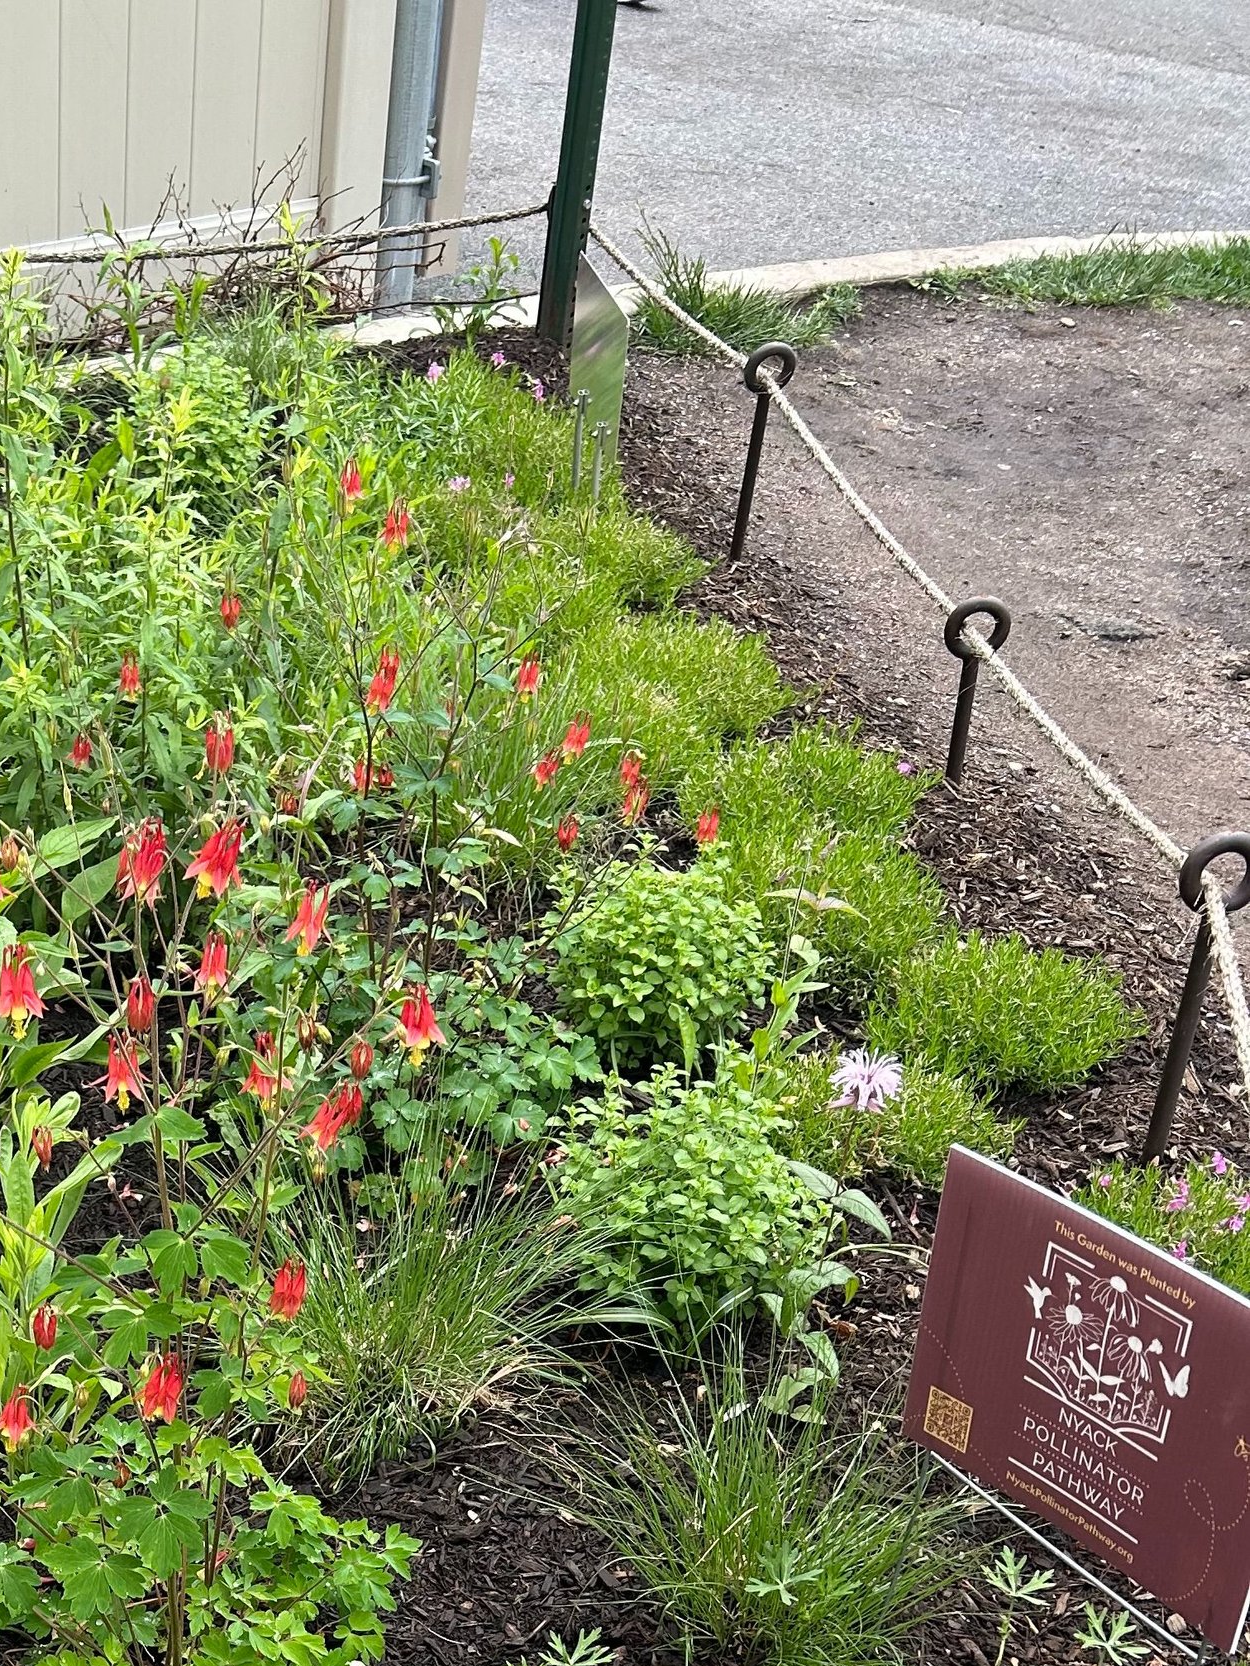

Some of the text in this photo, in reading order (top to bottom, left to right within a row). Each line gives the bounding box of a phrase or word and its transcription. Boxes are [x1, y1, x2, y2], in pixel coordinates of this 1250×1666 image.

[1054, 1220, 1196, 1310] This Garden was Planted by
[1023, 1416, 1144, 1505] POLLINATOR
[1058, 1407, 1118, 1457] NYACK
[1006, 1470, 1134, 1564] NyackPollinatorPathway.org
[1032, 1451, 1125, 1520] PATHWAY
